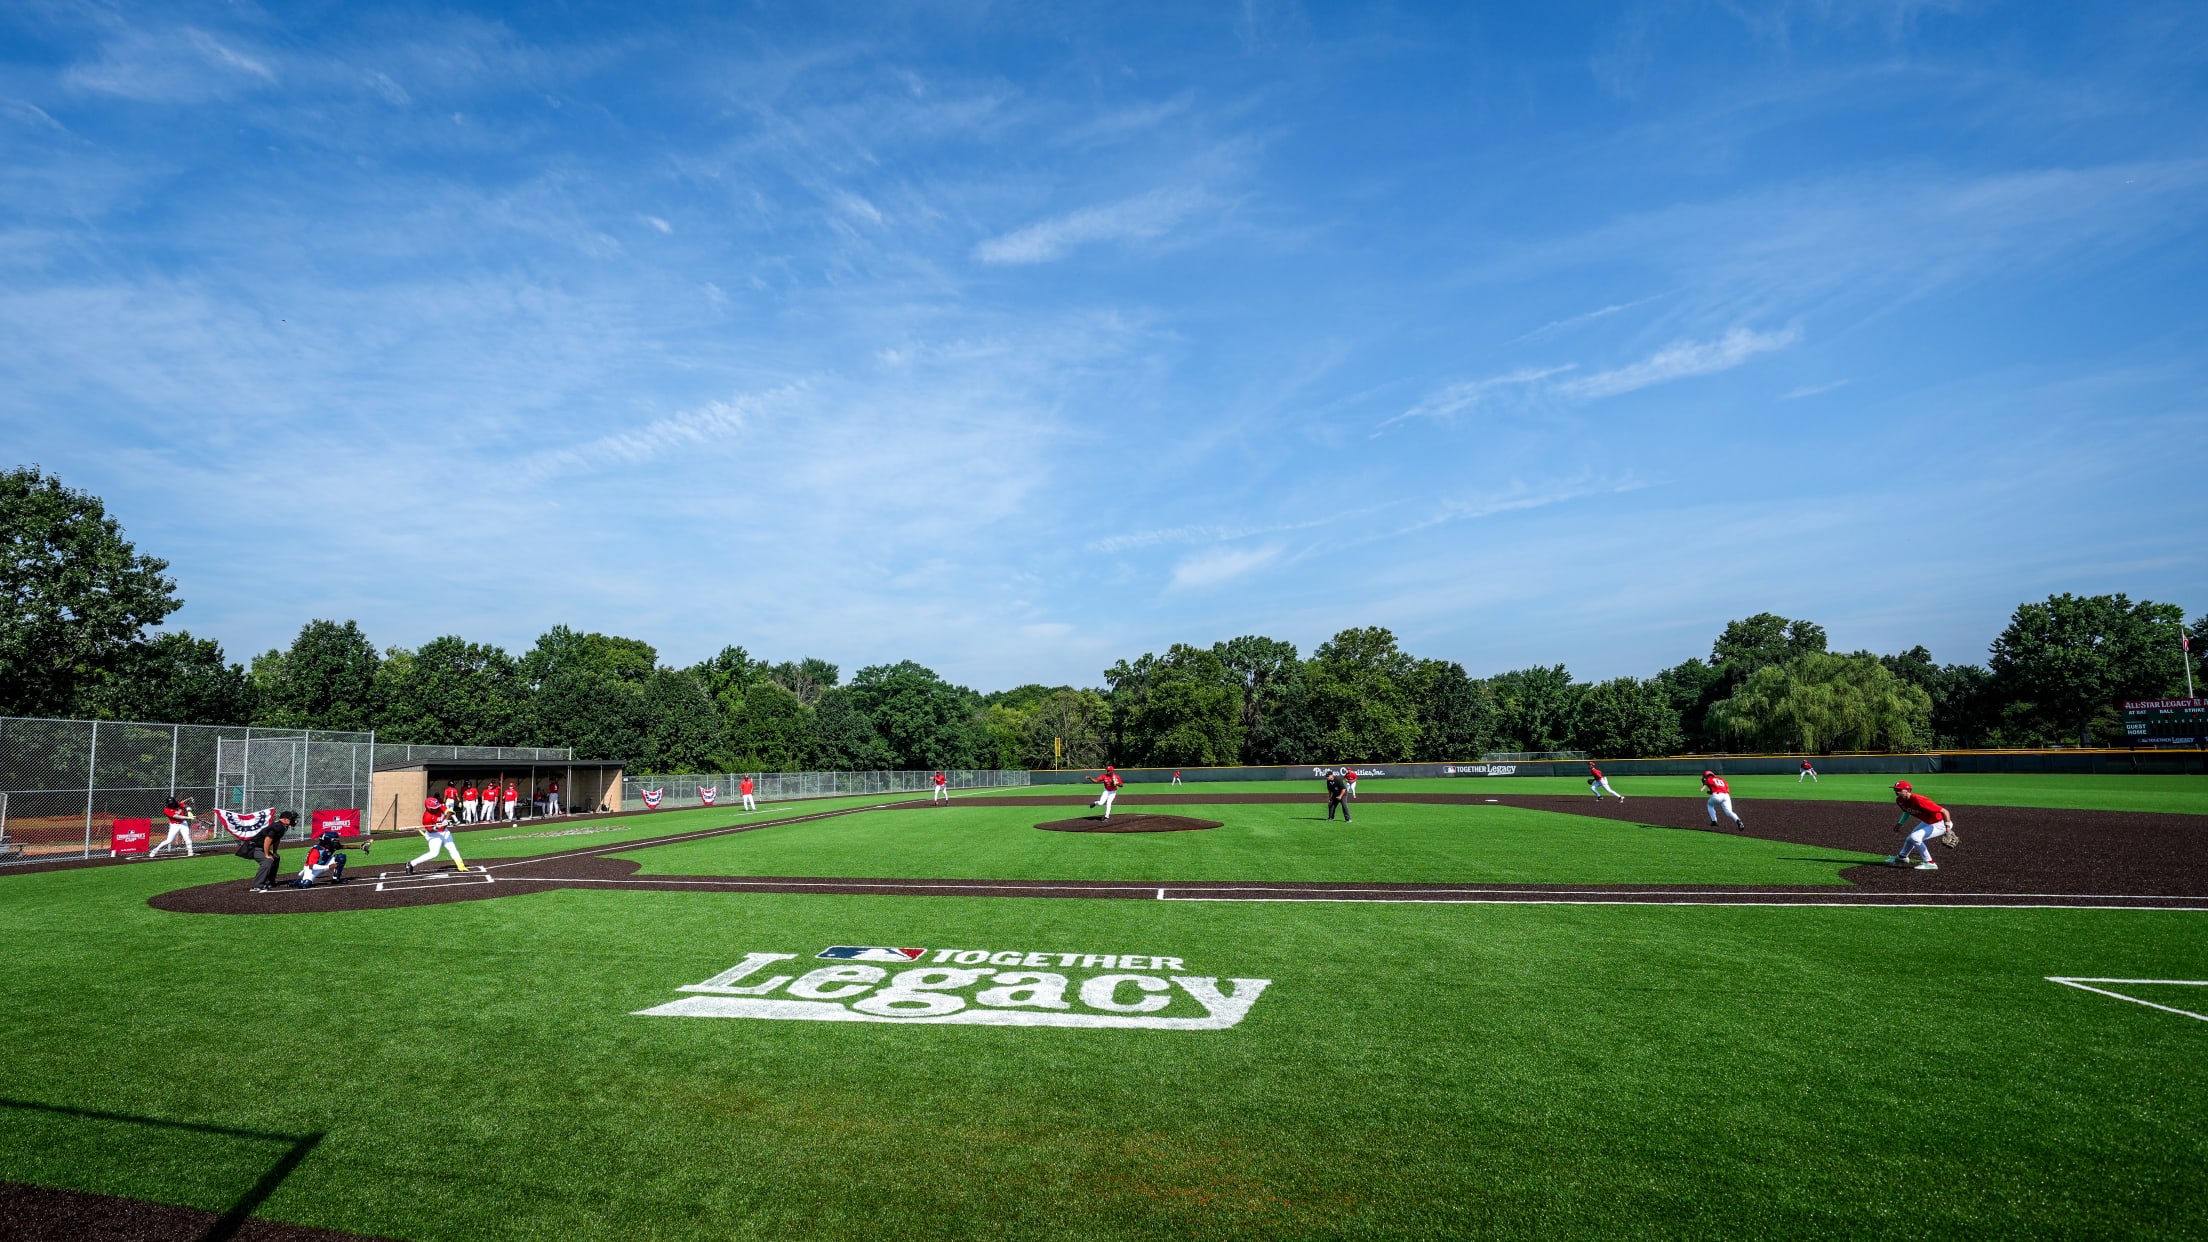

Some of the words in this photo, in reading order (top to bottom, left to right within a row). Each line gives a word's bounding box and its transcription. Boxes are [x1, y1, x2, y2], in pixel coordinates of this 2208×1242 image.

[2161, 700, 2191, 708] LEGACY
[1457, 765, 1486, 773] TOGETHER
[1486, 764, 1516, 776] Legacy
[932, 949, 1185, 971] TOGETHER
[630, 952, 1272, 1031] Legacy
